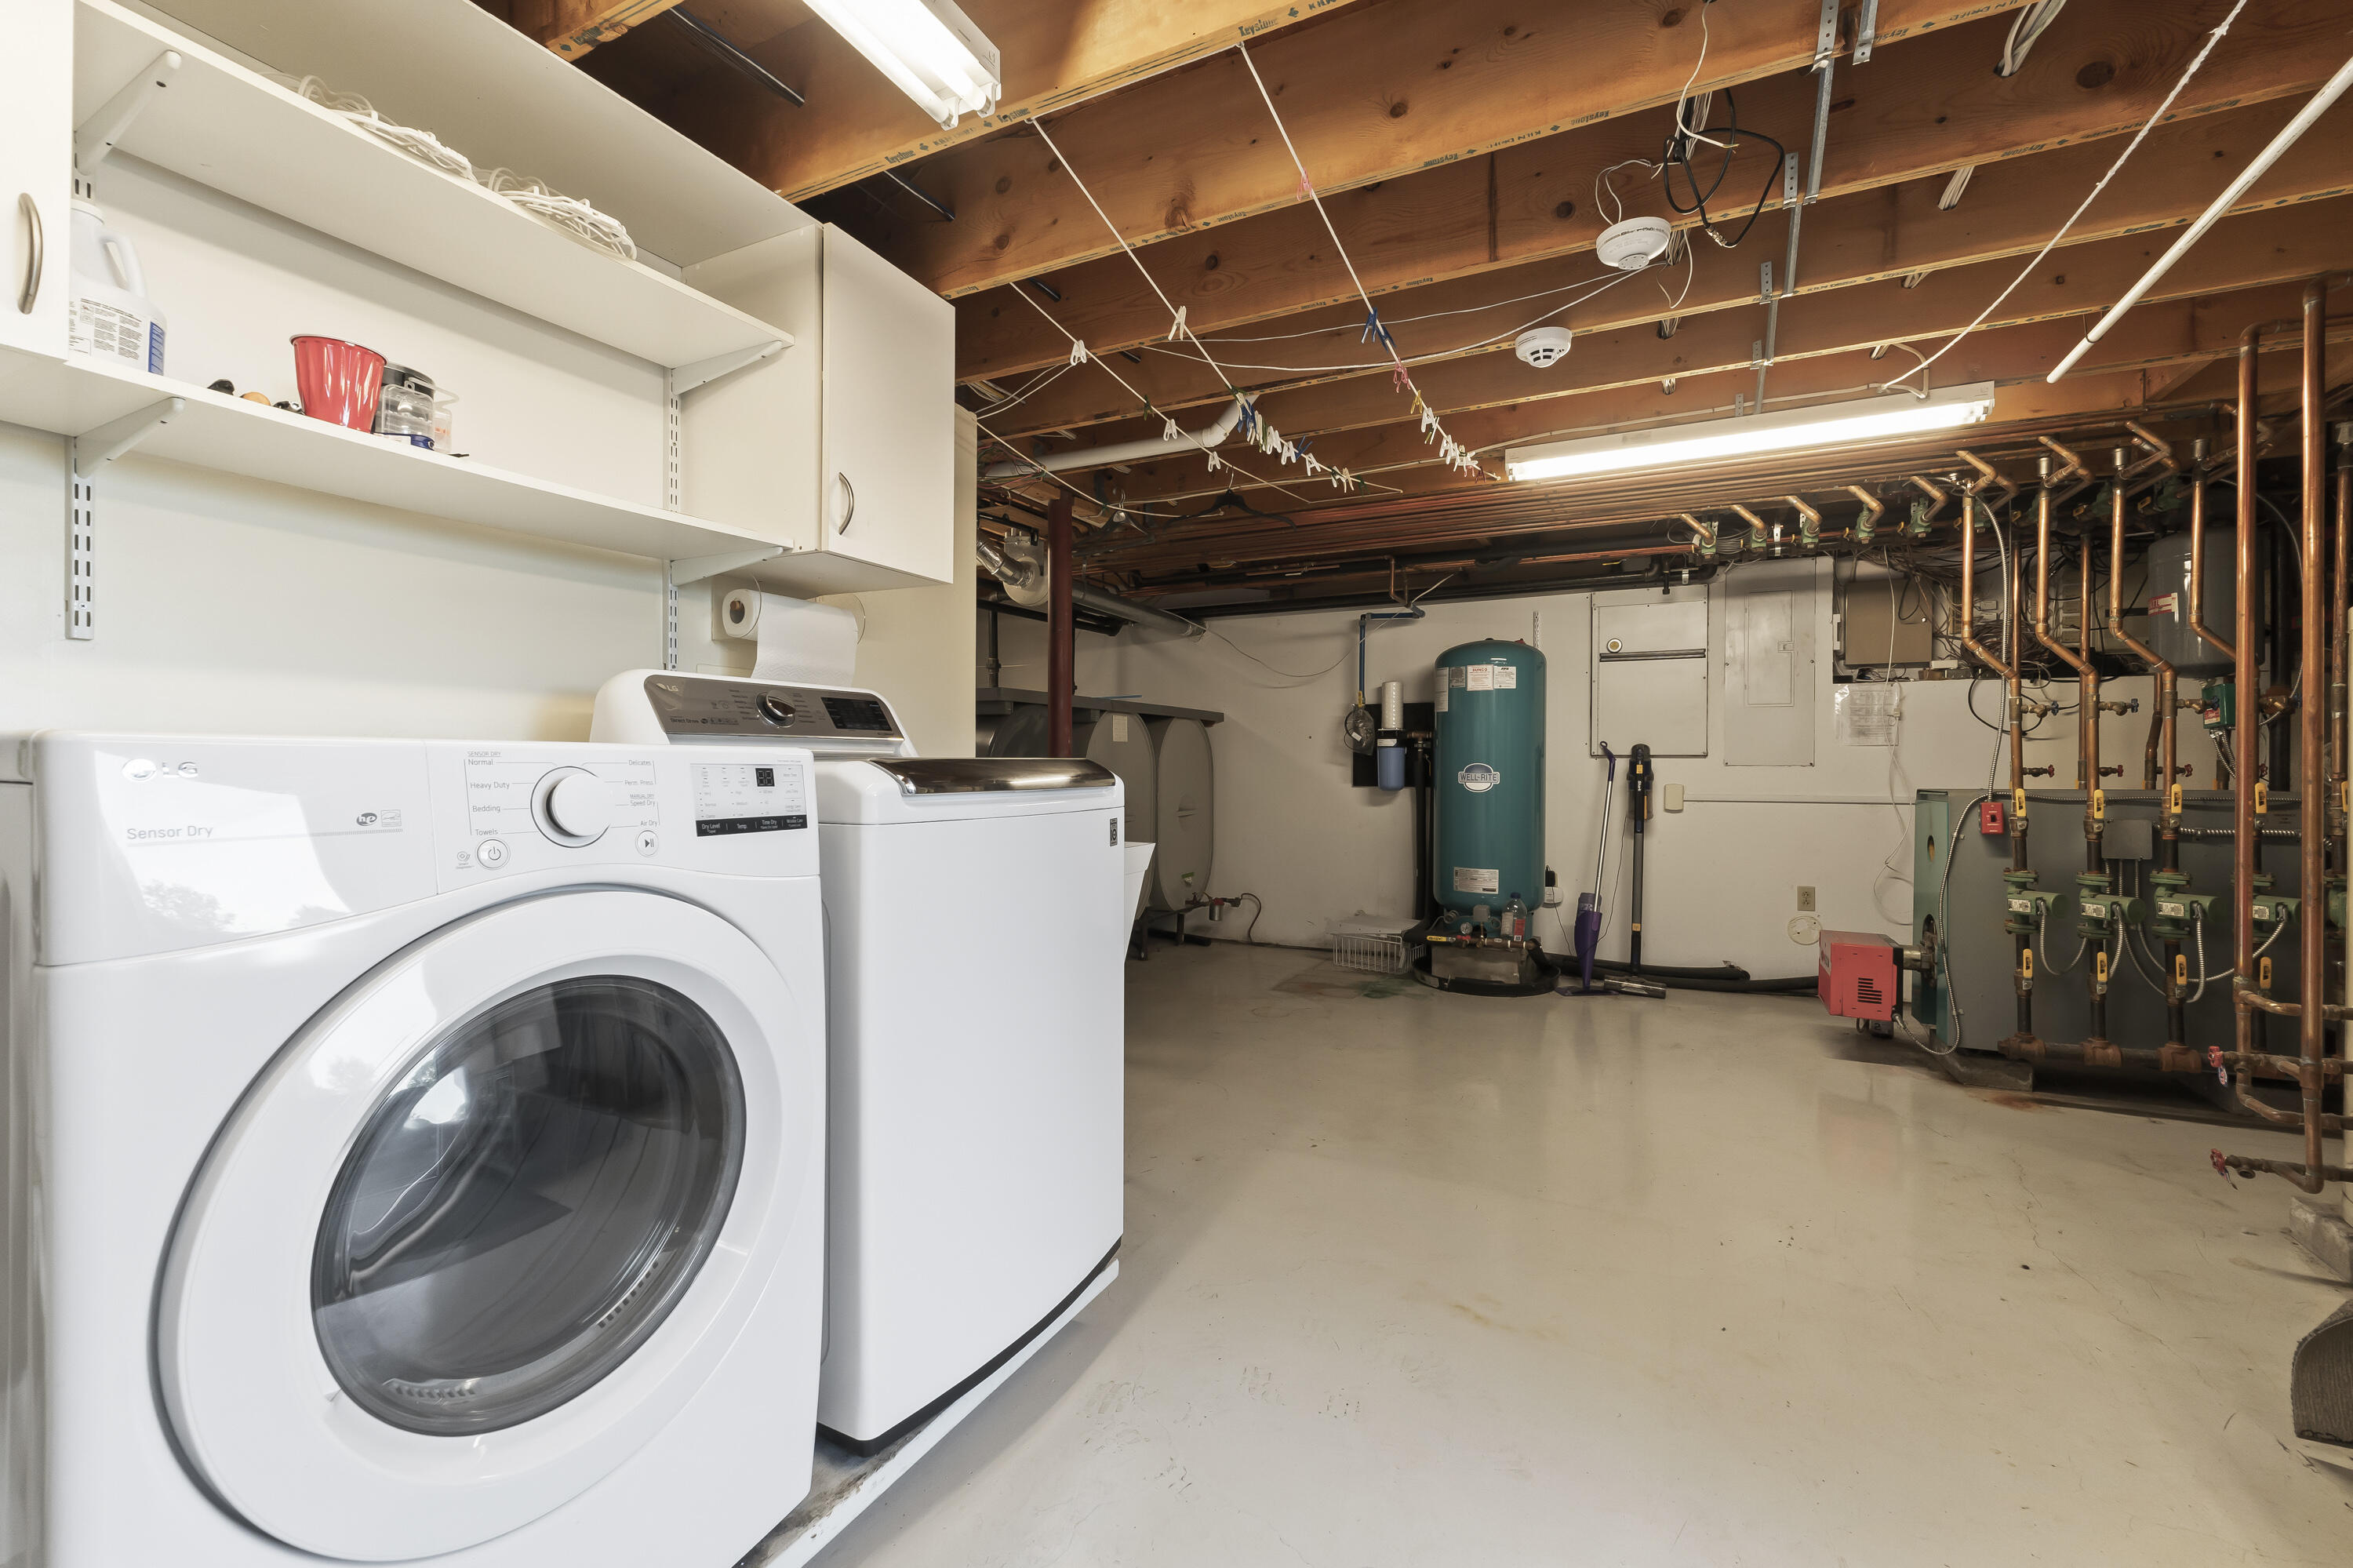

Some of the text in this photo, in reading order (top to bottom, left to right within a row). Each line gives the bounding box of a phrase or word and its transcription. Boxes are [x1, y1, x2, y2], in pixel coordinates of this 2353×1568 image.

[162, 761, 198, 778] LG
[493, 780, 511, 789] Duty
[472, 805, 501, 813] Bedding
[126, 825, 214, 840] Sensor Dry
[475, 828, 499, 836] Towels
